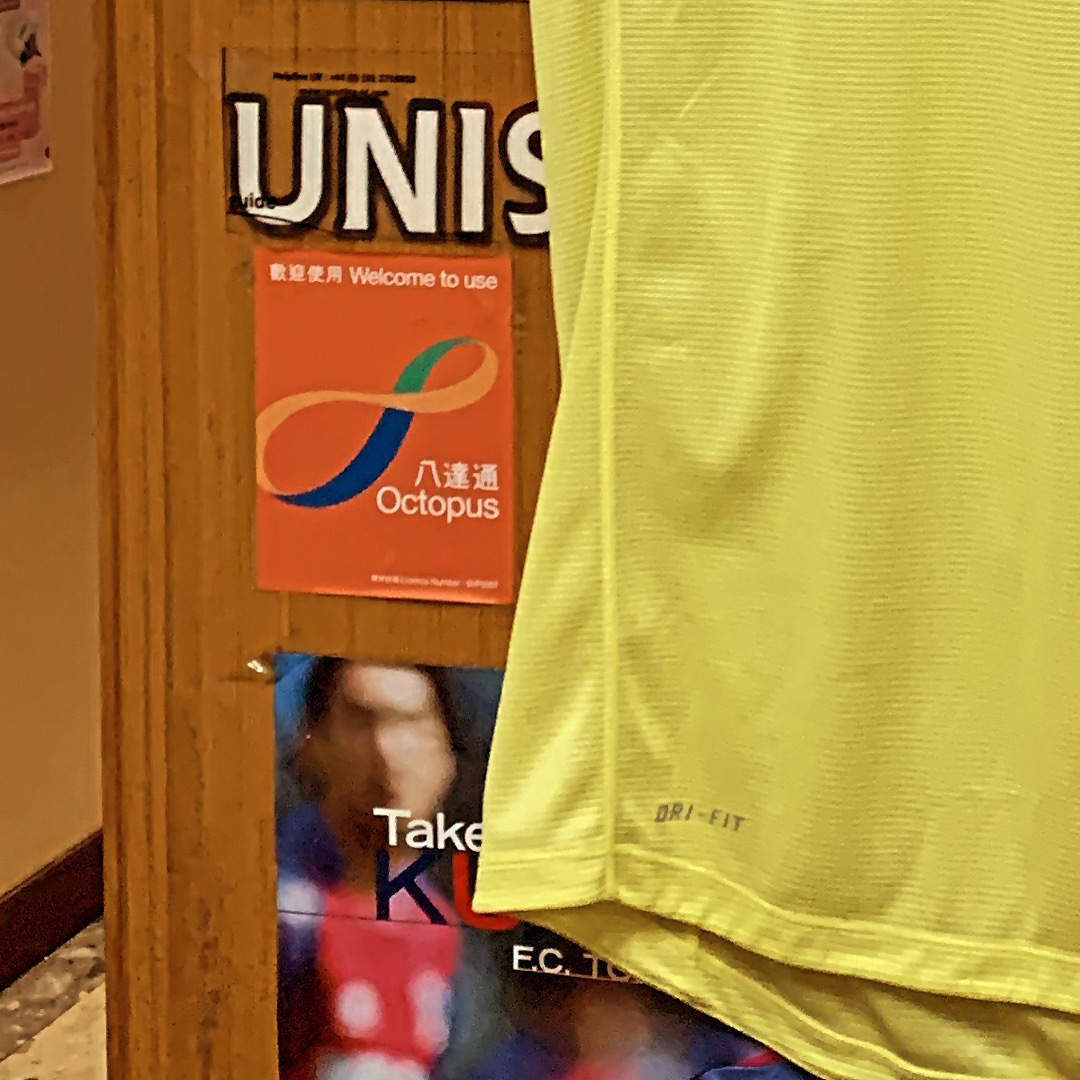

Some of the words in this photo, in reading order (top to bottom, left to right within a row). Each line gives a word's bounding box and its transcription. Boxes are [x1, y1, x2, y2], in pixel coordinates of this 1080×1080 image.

[349, 266, 436, 287] Welcome
[439, 269, 460, 289] to
[464, 274, 498, 290] use
[415, 460, 499, 491] 八達通
[376, 486, 500, 523] Octopus
[512, 945, 570, 976] F.C.
